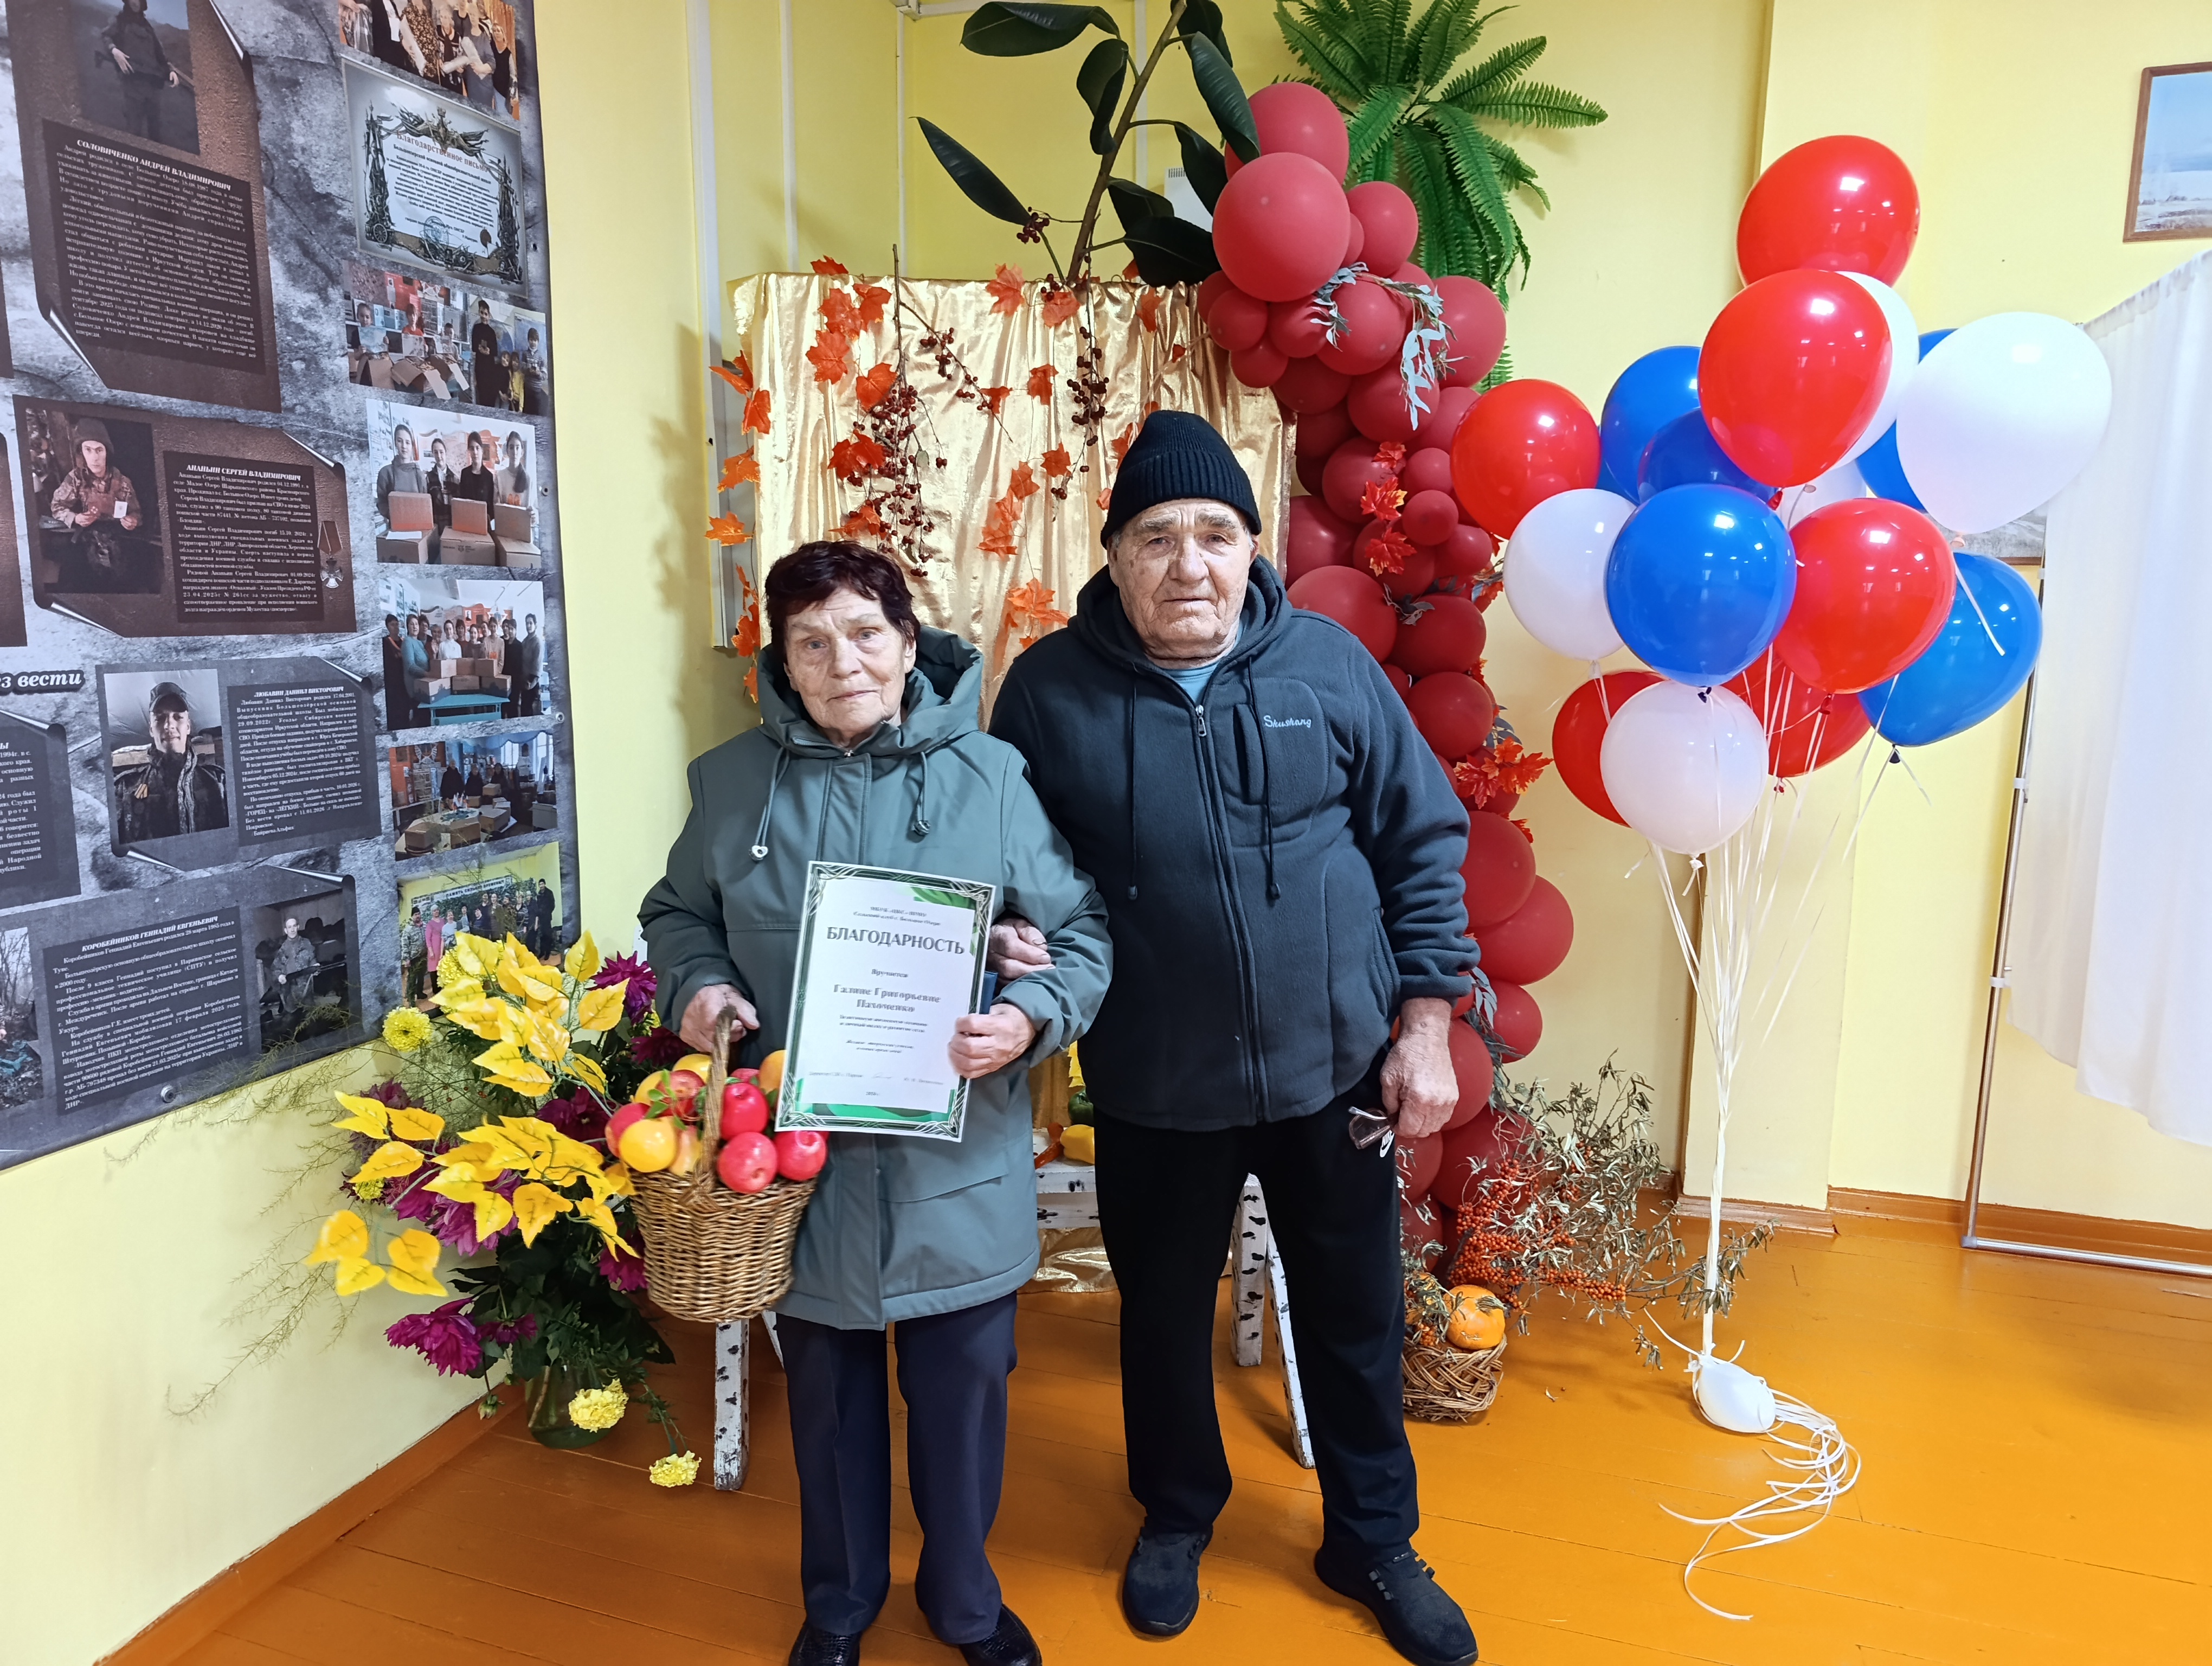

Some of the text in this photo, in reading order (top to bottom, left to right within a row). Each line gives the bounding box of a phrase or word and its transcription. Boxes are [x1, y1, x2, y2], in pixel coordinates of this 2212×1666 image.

[76, 138, 231, 192] СОЛОВИЧЕНКО АНДРЕЙ ВЛАДИМИРОВИЧ
[464, 159, 490, 173] письмо
[186, 464, 300, 480] АНАНЬИН СЕРГЕЙ ВЛАДИМИРОВИЧ
[17, 674, 81, 687] вести
[254, 690, 284, 698] ЛЮБАВИН
[308, 685, 344, 694] ВИКТОРОВИЧ
[8, 808, 28, 816] роты
[8, 853, 42, 864] Народной
[81, 915, 218, 951] КОРОБЕЙНИКОВ ГЕННАДИЙ ЕВГЕНЬЕВИЧ
[827, 927, 964, 954] БЛАГОДАРНОСТЬ
[63, 949, 104, 964] Коробейников
[105, 943, 132, 954] Геннадий
[132, 936, 163, 947] Евгеньевич
[164, 931, 184, 941] родился
[192, 926, 207, 934] марта
[113, 957, 140, 967] основную
[140, 943, 198, 960] общеобразовательную
[215, 934, 235, 943] окончил
[66, 984, 84, 994] После
[94, 978, 113, 986] класса
[116, 970, 144, 981] Геннадий
[146, 963, 171, 974] поступил
[215, 947, 236, 956] сельское
[59, 980, 73, 988] 2000
[73, 977, 87, 985] году.
[833, 984, 941, 1003] Галине Григорьевне
[61, 1043, 93, 1057] Геннадий
[96, 1032, 131, 1047] Евгеньевич
[134, 1020, 172, 1035] мобилизован
[184, 1010, 208, 1022] февраля
[211, 1005, 224, 1013] 2025
